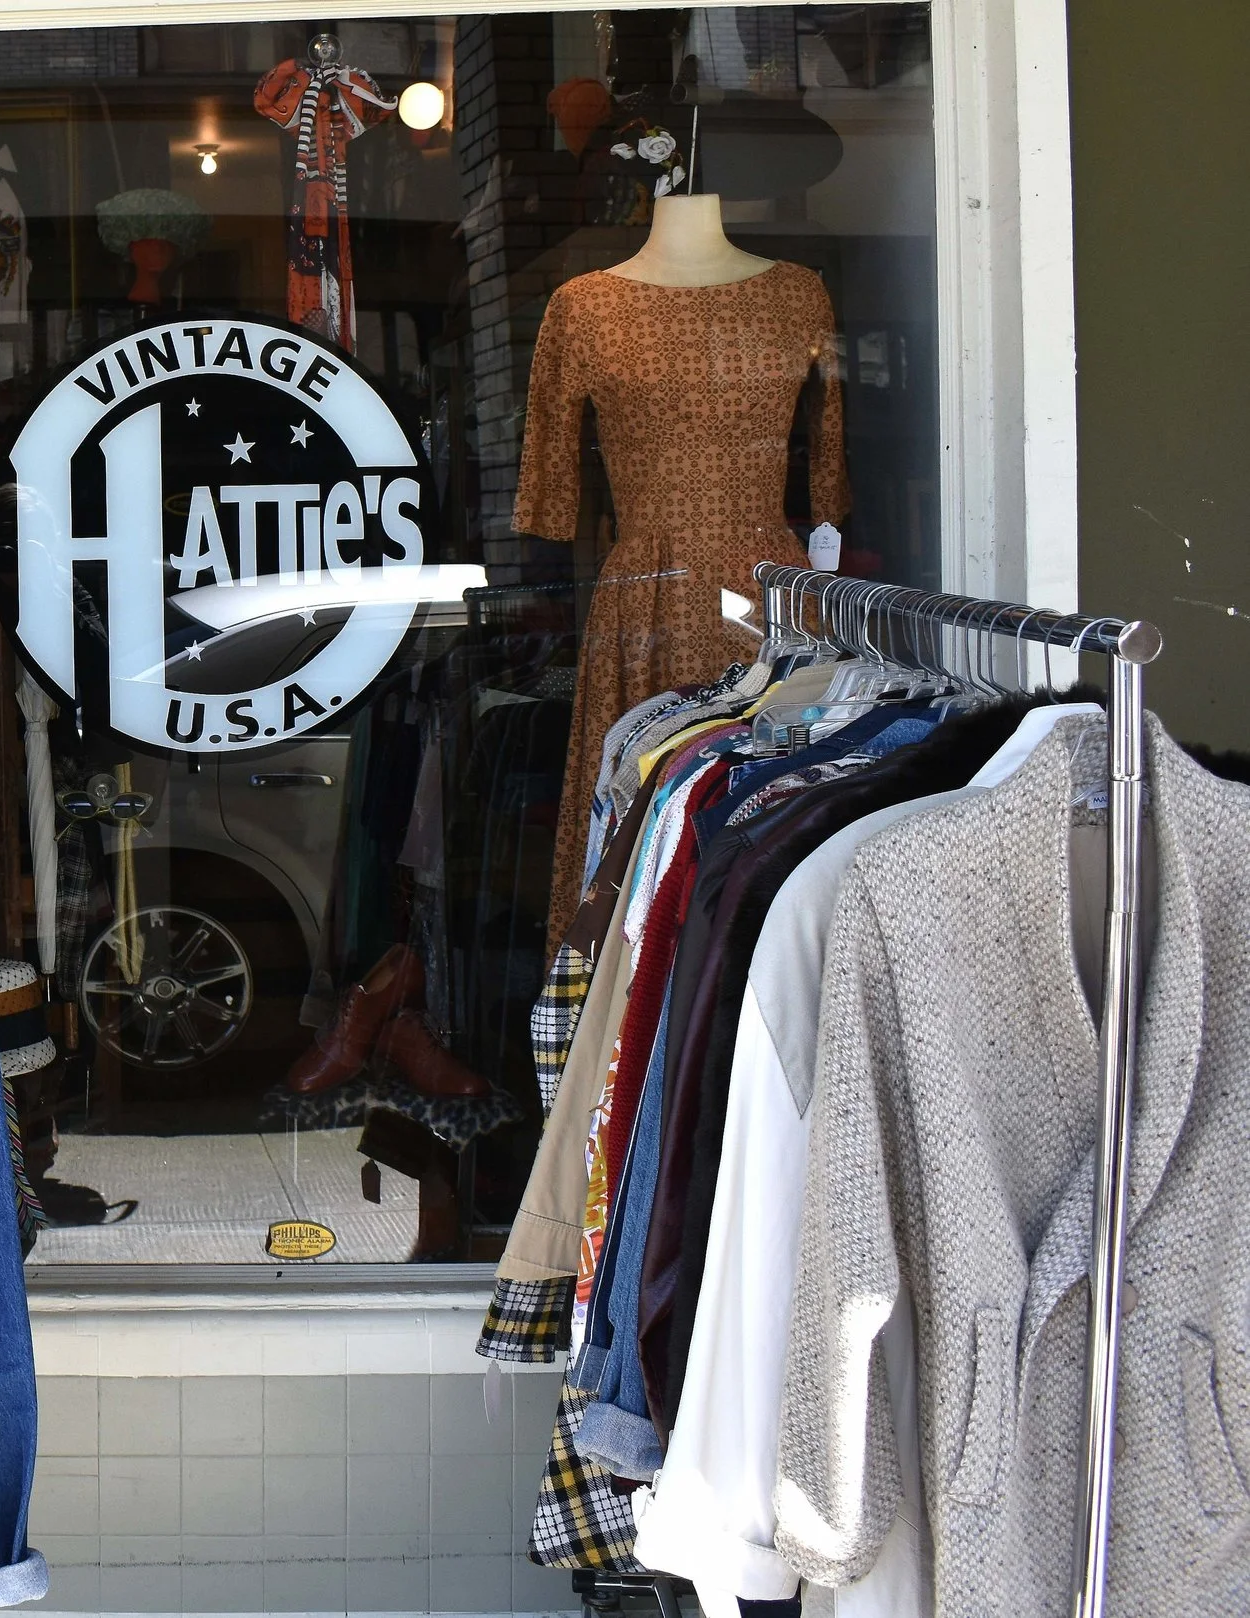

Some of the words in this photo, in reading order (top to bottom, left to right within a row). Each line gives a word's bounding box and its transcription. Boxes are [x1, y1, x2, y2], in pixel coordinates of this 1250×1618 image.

[73, 326, 340, 406] VINTAGE
[165, 682, 342, 744] U.S.A.
[273, 1226, 321, 1239] PHILLIPS
